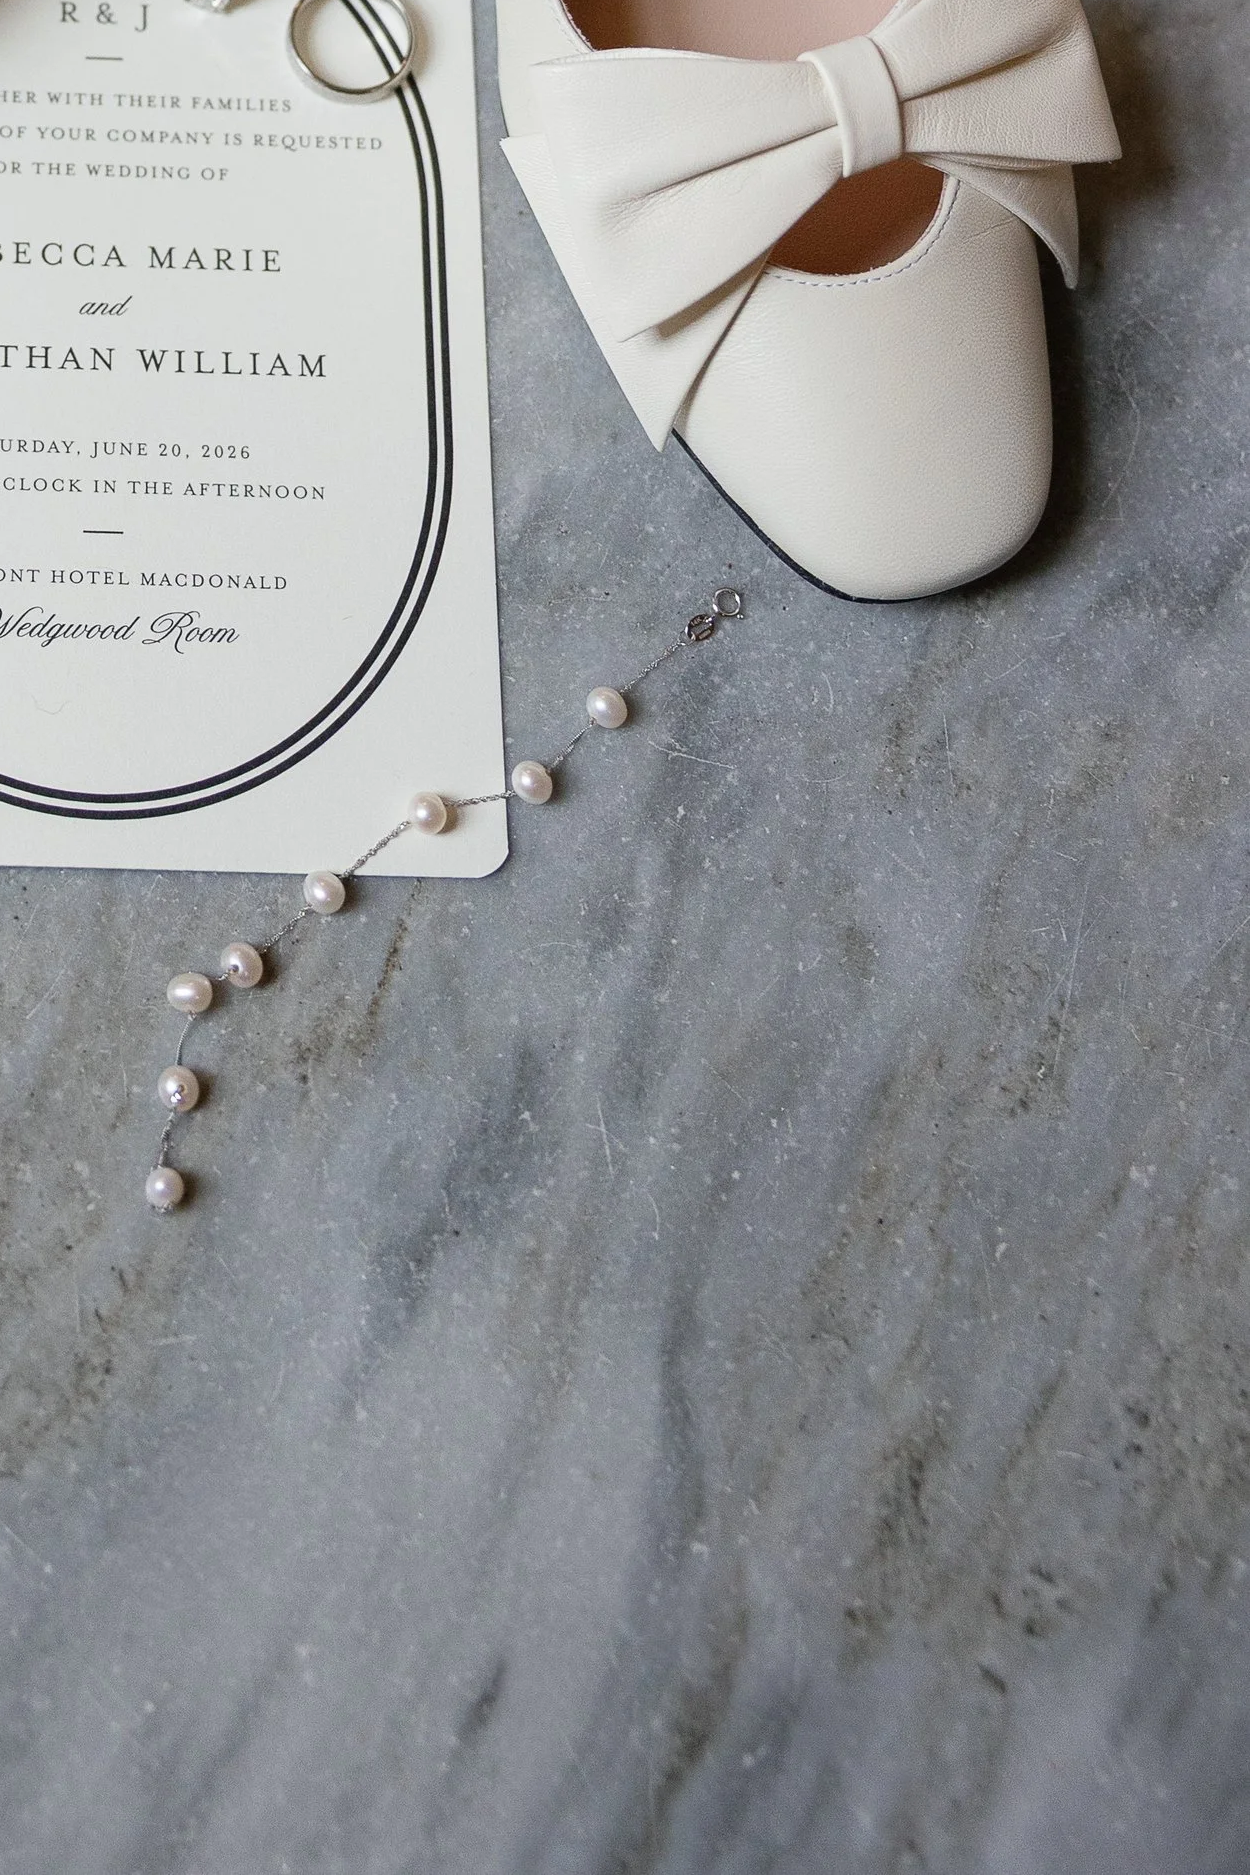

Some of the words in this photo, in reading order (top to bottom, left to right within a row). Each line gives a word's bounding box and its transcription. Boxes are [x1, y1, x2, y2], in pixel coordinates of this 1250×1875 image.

[60, 0, 80, 23] R
[95, 2, 117, 25] &
[134, 3, 149, 33] J
[46, 91, 104, 107] WITH
[113, 93, 182, 109] THEIR
[191, 96, 292, 113] FAMILIES
[35, 126, 97, 142] YOUR
[106, 128, 214, 146] COMPANY
[224, 132, 243, 147] IS
[253, 133, 383, 153] REQUESTED
[31, 161, 76, 177] THE
[85, 163, 191, 180] WEDDING
[200, 167, 229, 182] OF
[149, 245, 281, 273] MARIE
[78, 295, 133, 317] and
[135, 348, 327, 378] WILLIAM
[89, 441, 148, 459] JUNE
[158, 442, 190, 460] 20,
[201, 444, 250, 460] 2026
[93, 479, 117, 494] IN
[126, 480, 173, 496] THE
[182, 482, 325, 500] AFTERNOON
[50, 569, 130, 586] HOTEL
[139, 572, 287, 590] MACDONALD
[141, 610, 240, 655] Room
